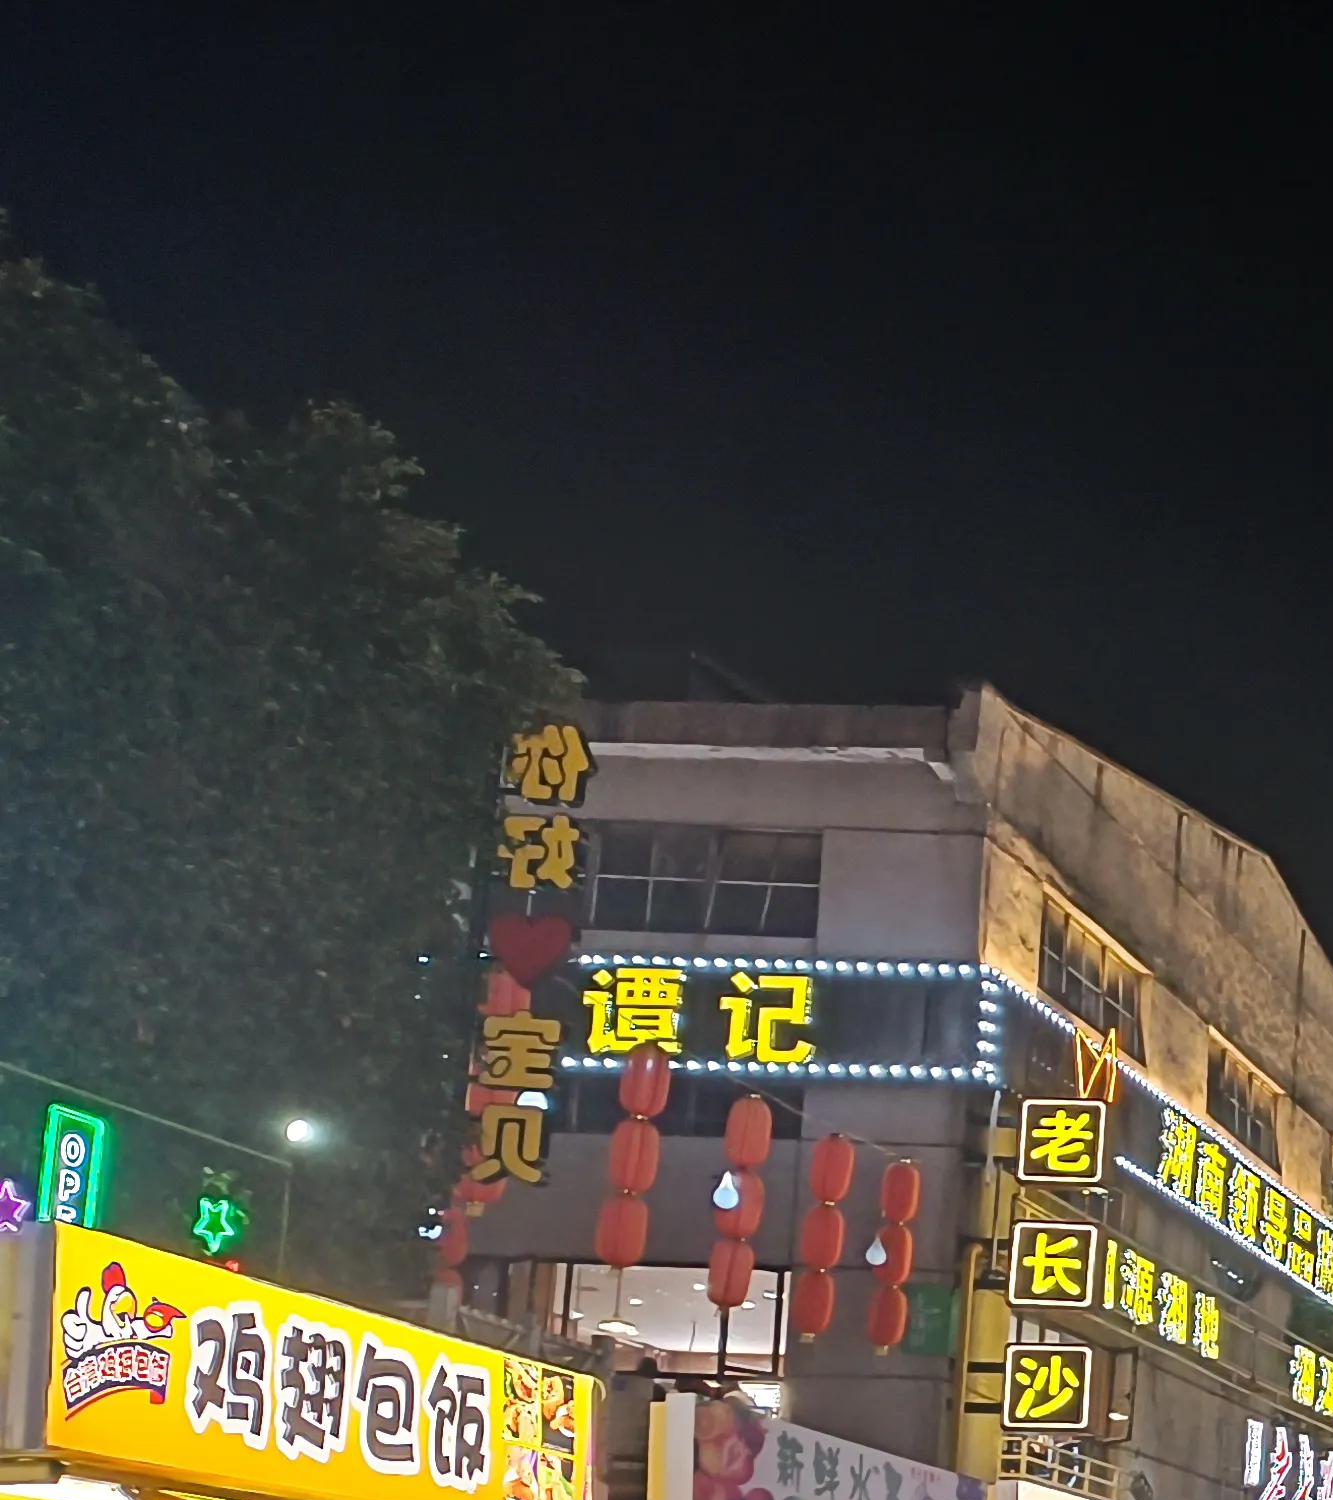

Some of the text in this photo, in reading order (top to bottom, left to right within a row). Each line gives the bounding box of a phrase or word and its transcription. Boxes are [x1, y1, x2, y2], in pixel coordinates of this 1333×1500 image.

[582, 966, 814, 1064] 谭记
[191, 1305, 491, 1486] 鸡翅包饭
